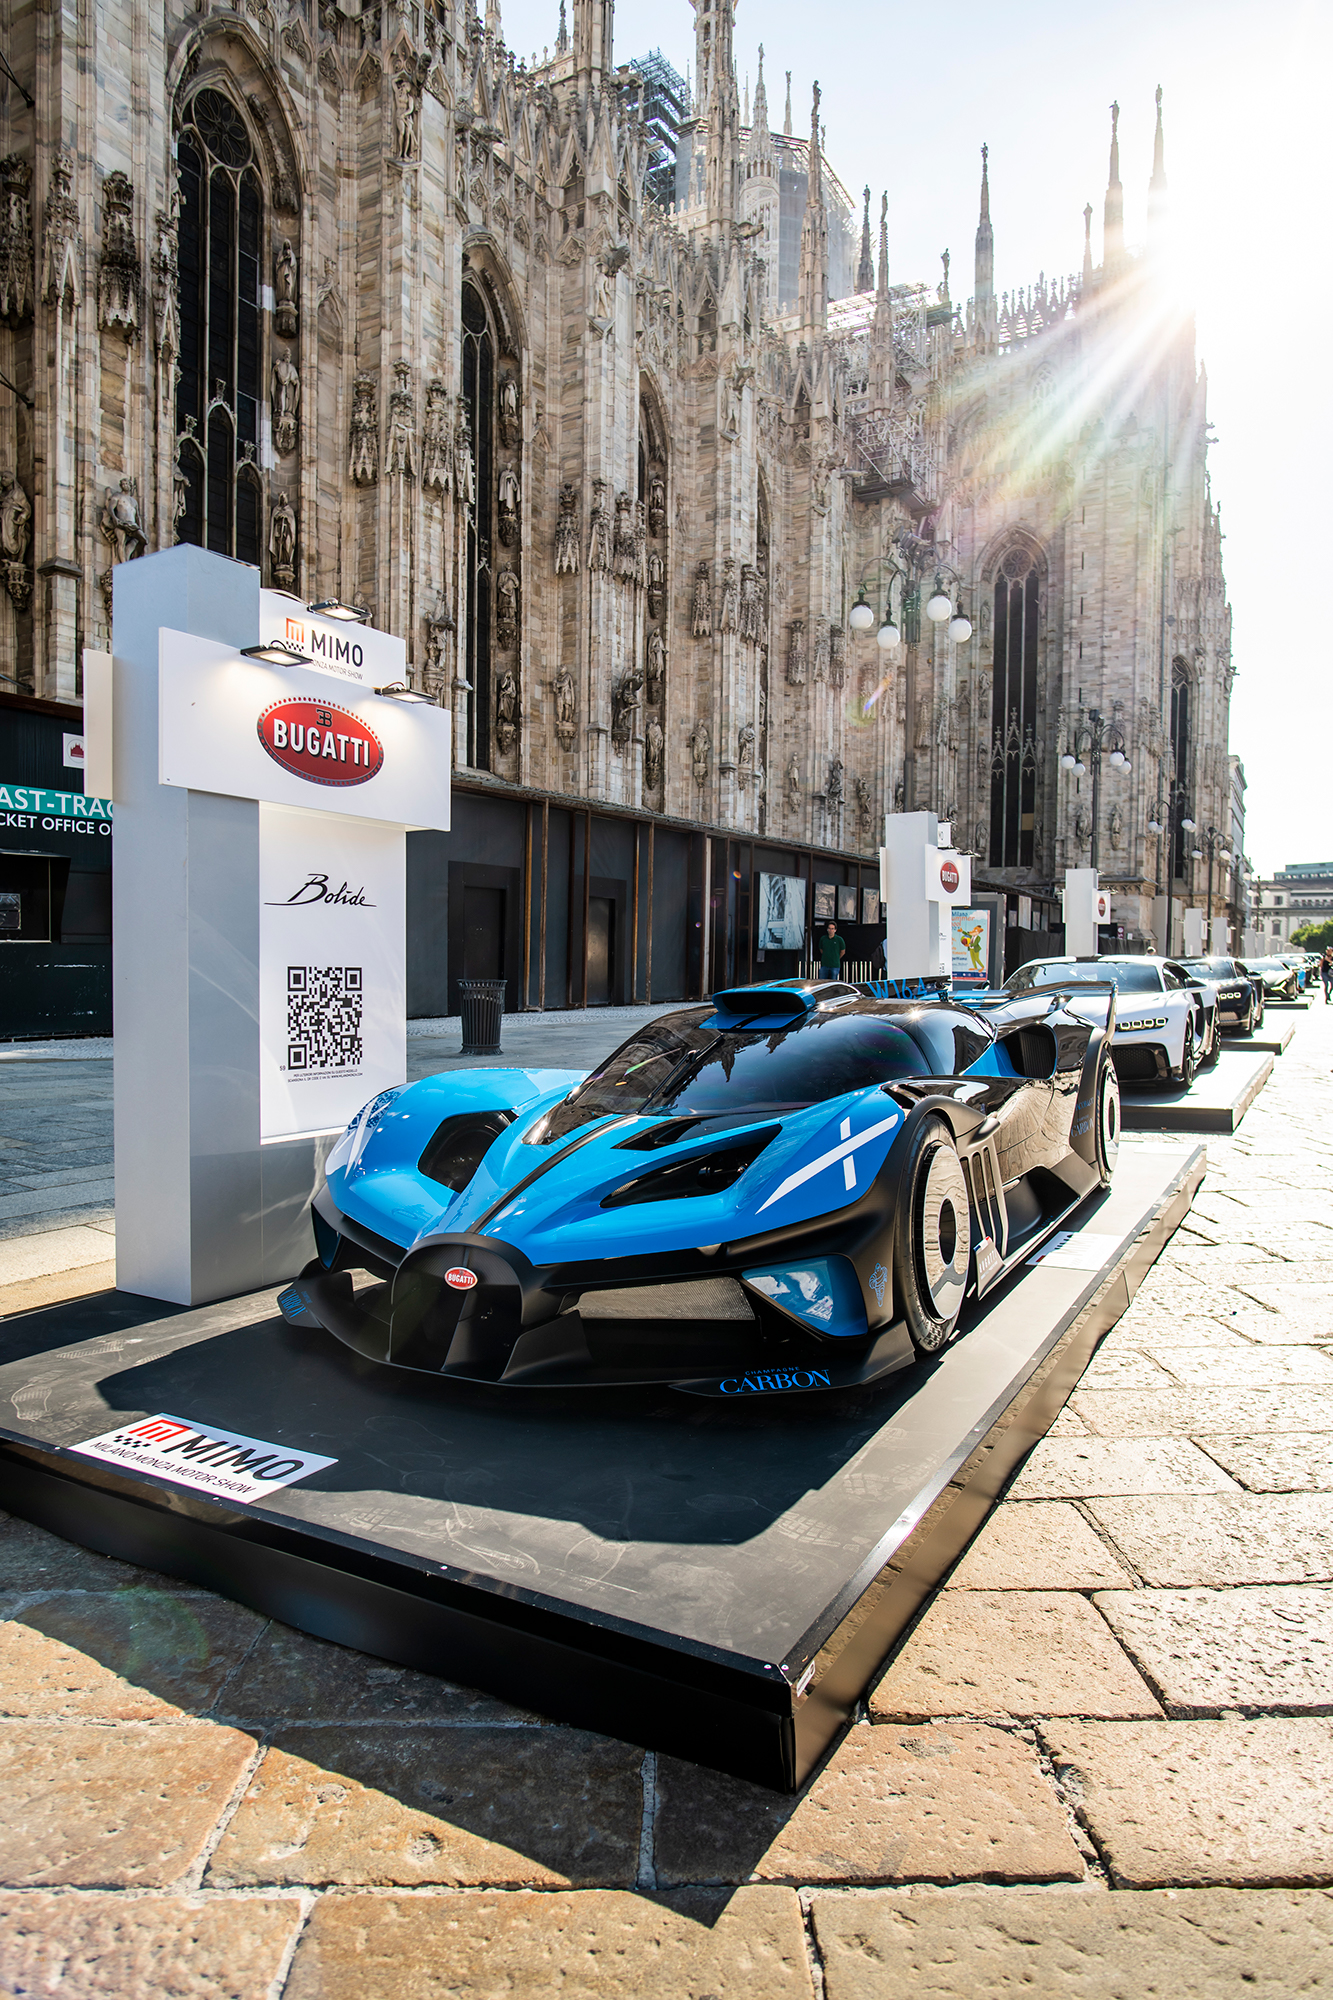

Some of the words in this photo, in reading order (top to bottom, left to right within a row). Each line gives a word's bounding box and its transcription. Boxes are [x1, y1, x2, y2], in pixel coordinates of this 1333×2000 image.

[310, 629, 364, 668] MIMO
[347, 669, 364, 680] SHOW
[273, 718, 370, 768] BUGATTI
[41, 817, 95, 834] OFFICE
[98, 822, 113, 836] O
[263, 873, 377, 908] Bolide
[448, 1273, 474, 1285] BUGATTI
[719, 1369, 831, 1394] CARBON
[745, 1366, 800, 1376] CHAMPAGNE
[90, 1441, 134, 1459] MILANO
[131, 1454, 175, 1471] MONZA
[170, 1465, 217, 1484] MOTOR
[212, 1478, 256, 1494] SHOW
[161, 1434, 305, 1481] MIMO
